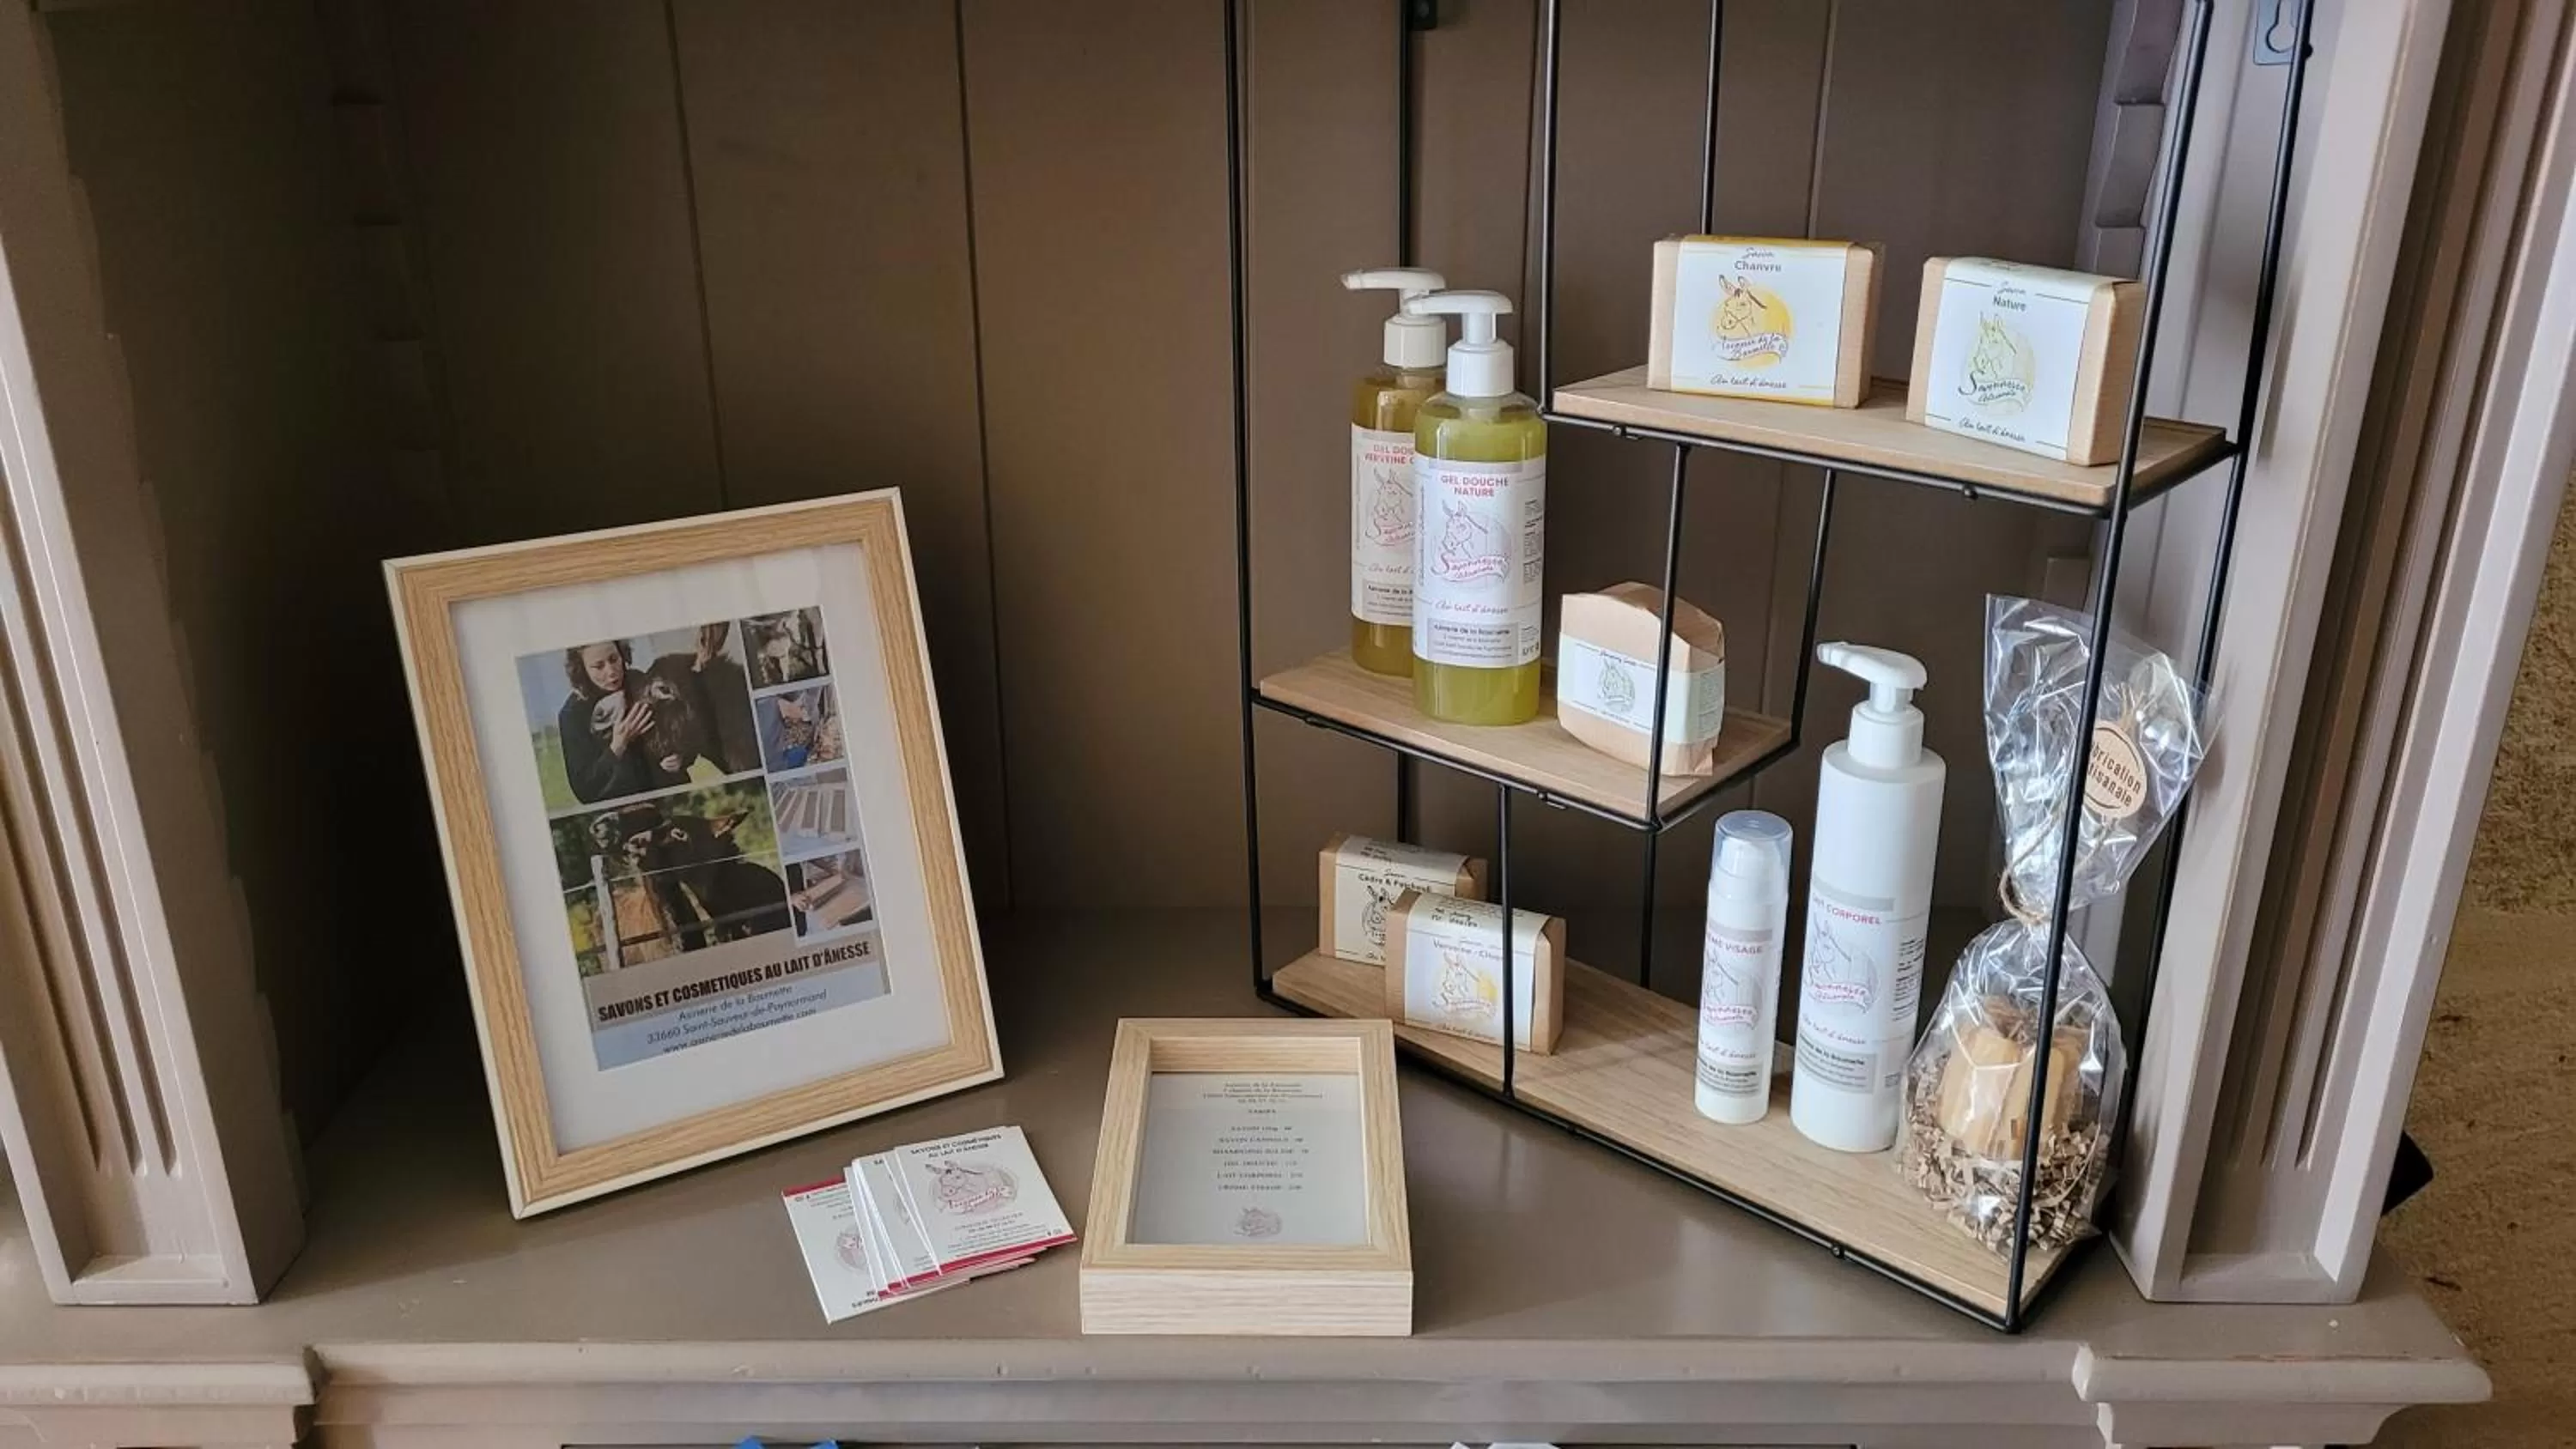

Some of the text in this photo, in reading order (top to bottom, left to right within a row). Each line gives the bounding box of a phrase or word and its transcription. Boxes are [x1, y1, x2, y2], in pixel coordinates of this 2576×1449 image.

[1734, 260, 1783, 273] Chanvre
[1993, 295, 2027, 312] Nature
[1441, 474, 1510, 488] GEL DOUCHE
[1454, 486, 1495, 497] NATURE
[2092, 742, 2142, 795] brication
[2088, 761, 2133, 808] tisanale
[1826, 904, 1881, 925] CORPOREL
[1725, 943, 1763, 955] VISAGE
[598, 940, 872, 1022] SAVONS ET COSMETIQUES AU LAIT D'ÂNESSE
[720, 1001, 734, 1012] de
